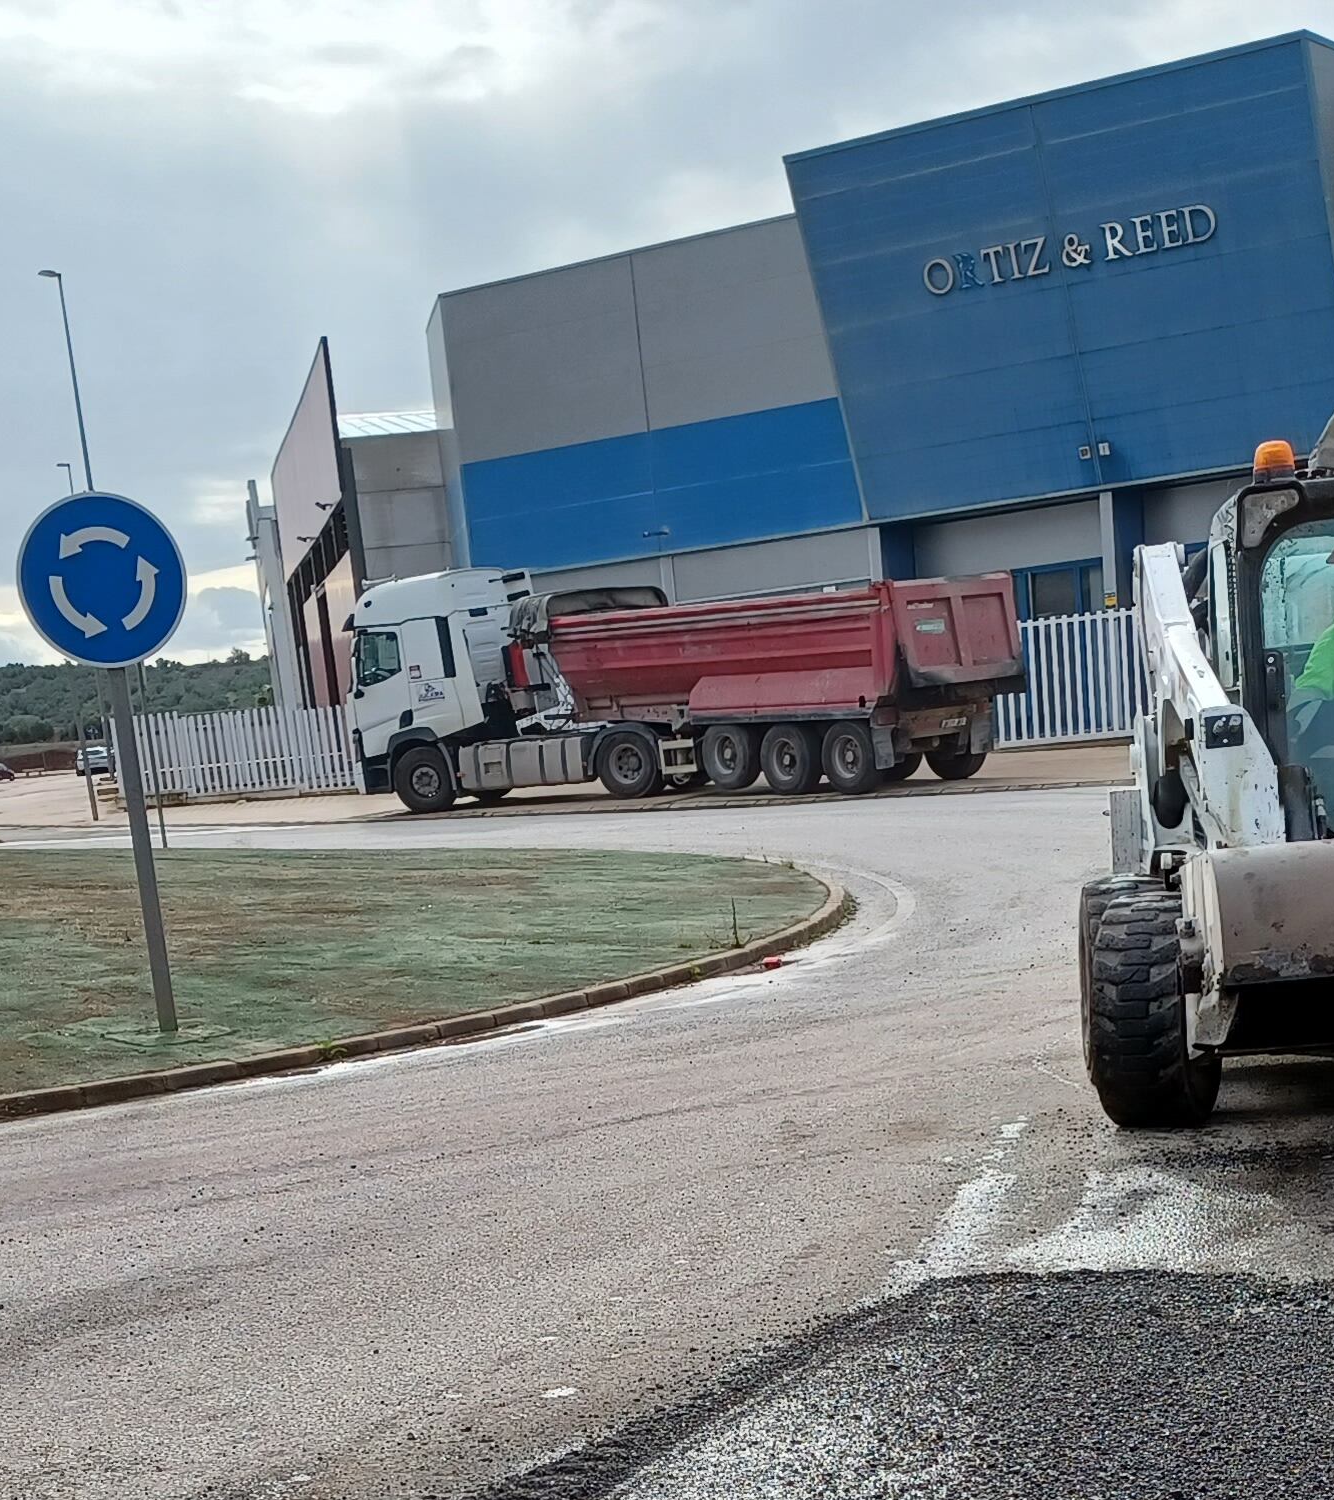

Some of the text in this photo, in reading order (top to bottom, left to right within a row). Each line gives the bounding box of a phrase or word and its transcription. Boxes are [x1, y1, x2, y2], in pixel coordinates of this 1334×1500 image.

[923, 203, 1216, 295] ORTIZ & REED
